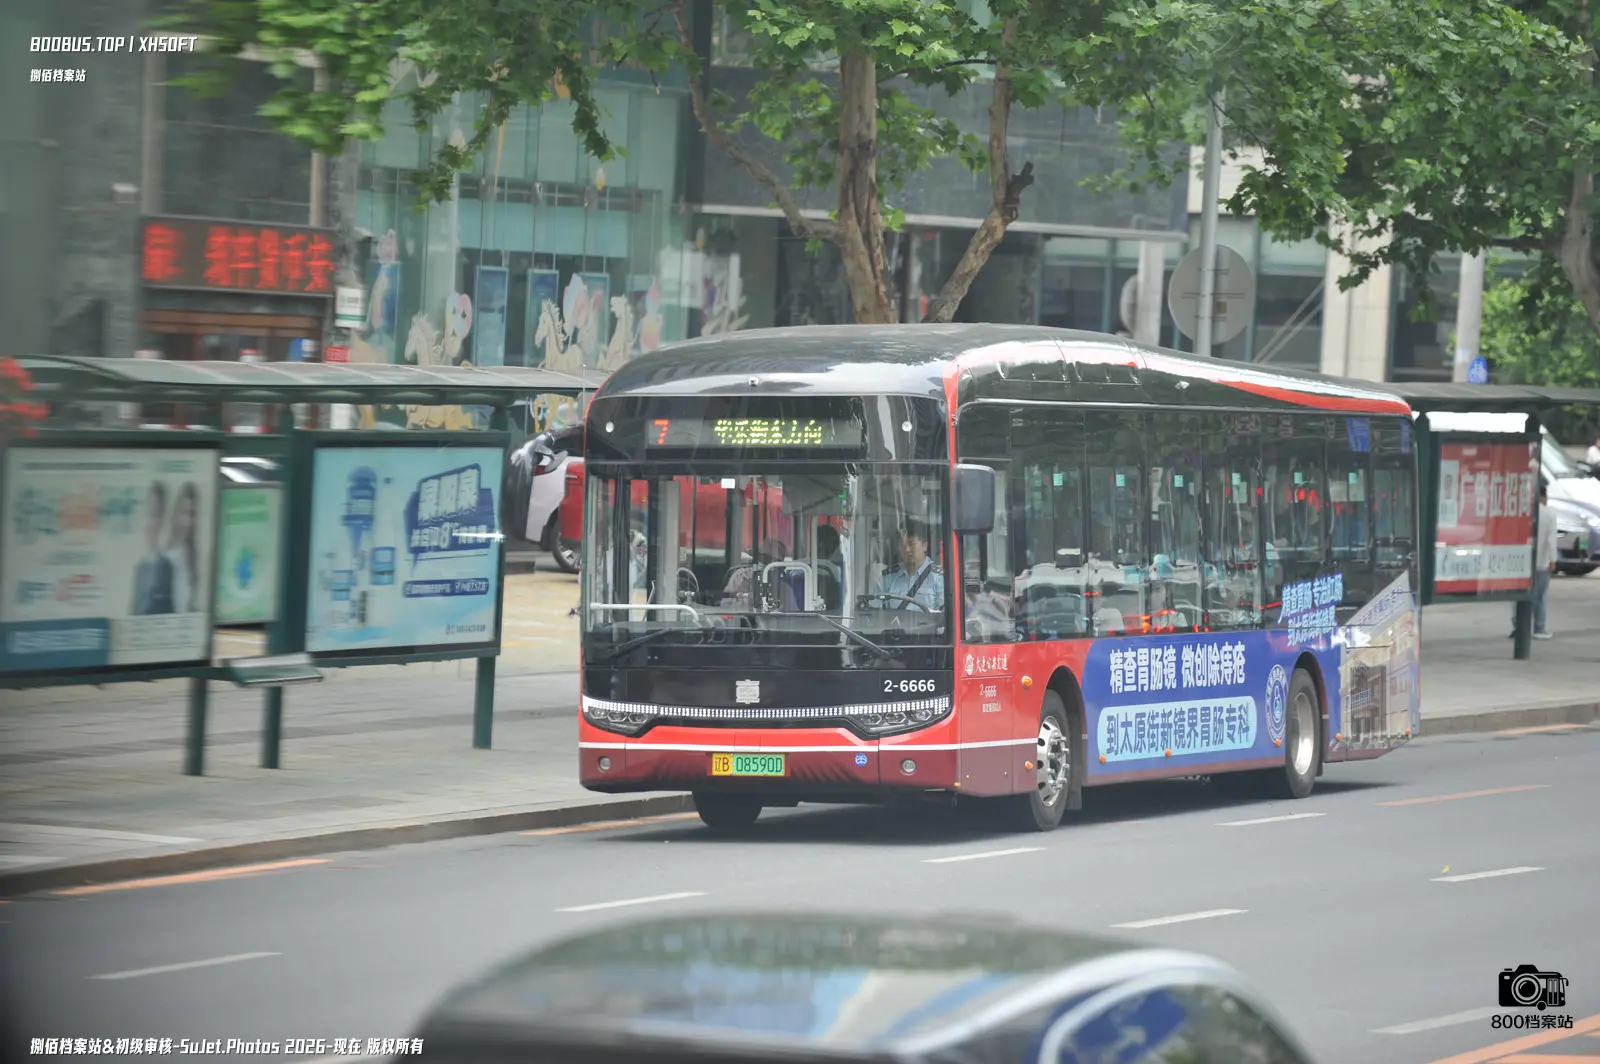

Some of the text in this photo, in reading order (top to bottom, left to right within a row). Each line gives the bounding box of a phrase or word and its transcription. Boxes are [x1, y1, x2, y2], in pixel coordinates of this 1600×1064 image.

[654, 420, 669, 445] 7
[1459, 472, 1532, 518] 广告位招商
[1279, 582, 1312, 624] 精查胃肠
[883, 679, 936, 693] 2-6666
[1109, 641, 1246, 694] 精查胃肠镜 微创除痔疮
[979, 683, 997, 698] 2-6666
[1106, 703, 1249, 756] 到太原街新镜界胃肠专科
